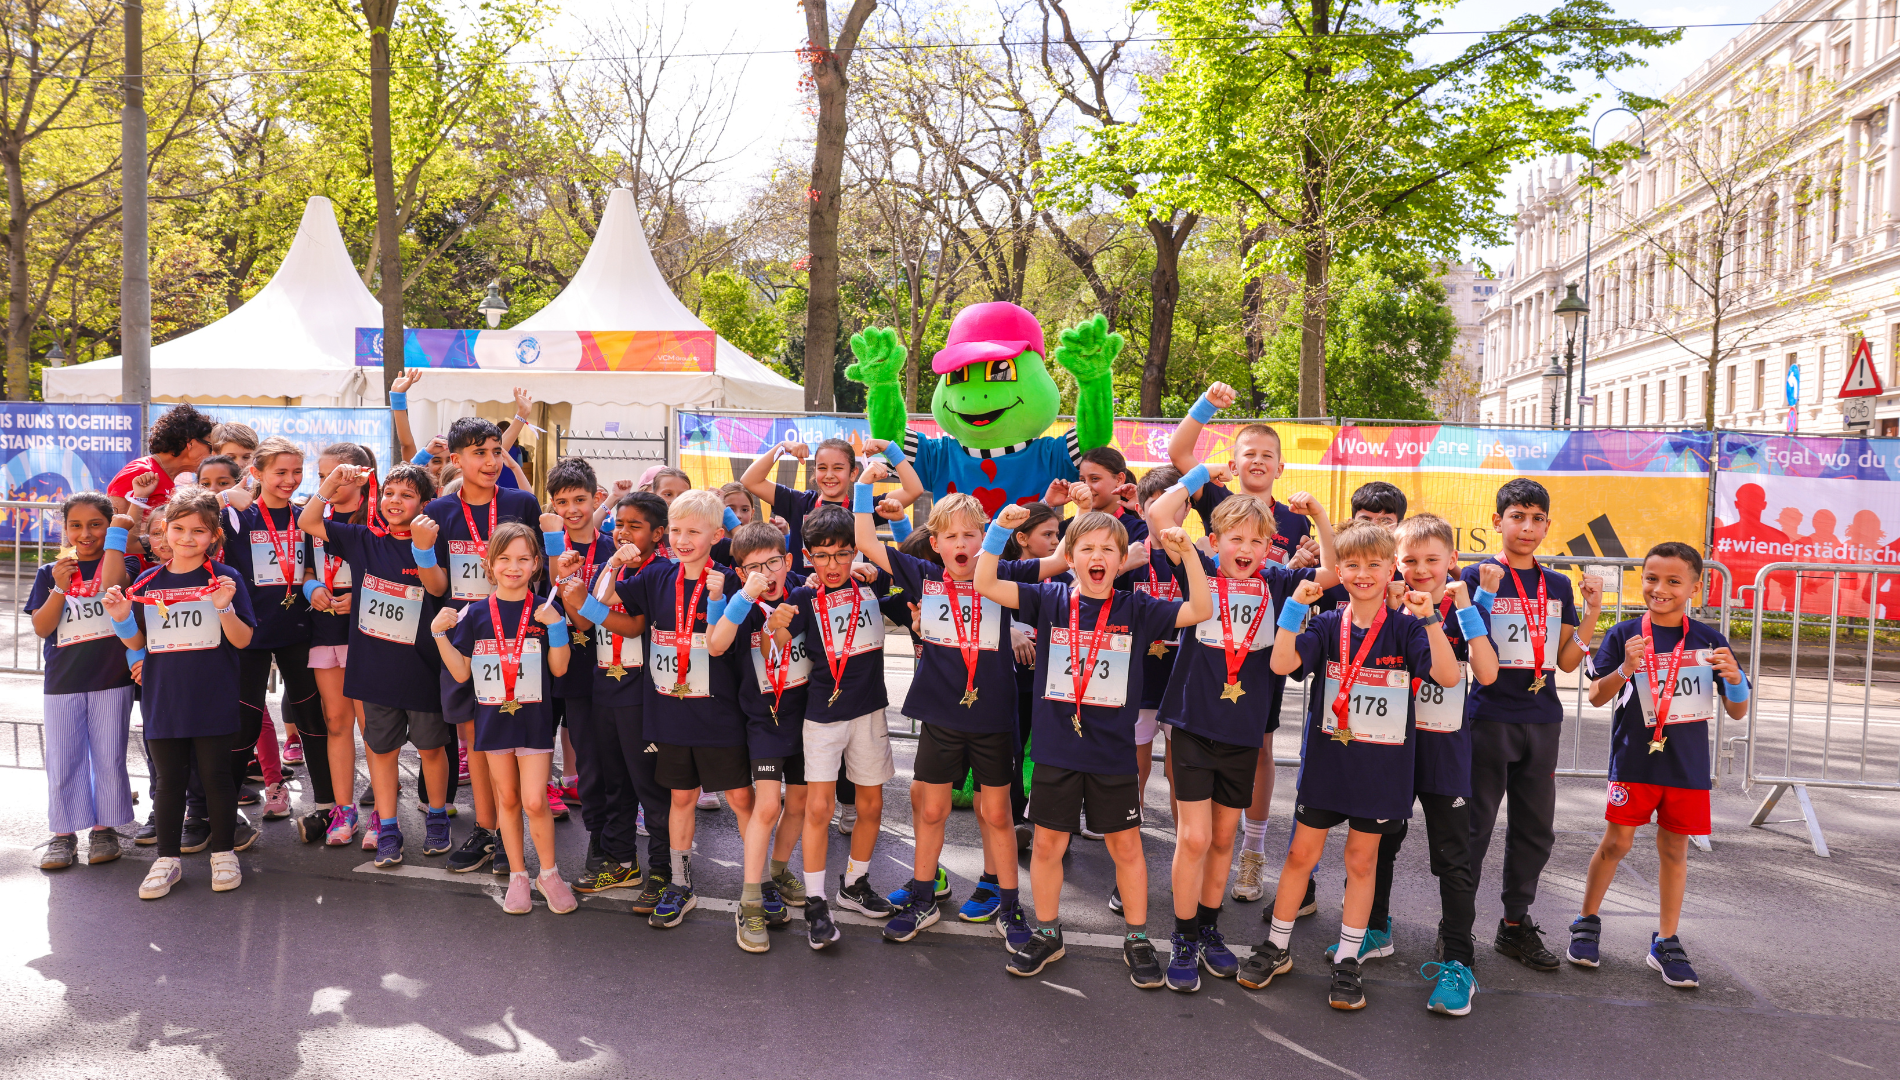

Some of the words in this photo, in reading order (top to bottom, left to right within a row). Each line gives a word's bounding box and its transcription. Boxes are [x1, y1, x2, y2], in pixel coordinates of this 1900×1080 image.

[17, 414, 54, 429] RUNS
[58, 414, 132, 430] TOGETHER
[284, 418, 380, 435] COMMUNITY
[0, 434, 55, 450] STANDS
[58, 435, 132, 452] TOGETHER
[785, 428, 823, 444] Oida
[1158, 451, 1170, 460] VC
[1337, 438, 1388, 458] Wow,
[1395, 442, 1430, 459] you
[1437, 441, 1469, 456] are
[1476, 437, 1548, 458] insane!
[1764, 446, 1811, 468] Egal
[1818, 453, 1850, 467] wo
[1858, 450, 1886, 468] du
[268, 550, 304, 565] 29
[65, 601, 104, 623] 2150
[162, 610, 202, 629] 2170
[368, 599, 404, 621] 2186
[939, 604, 982, 623] 28
[483, 662, 524, 681] 214
